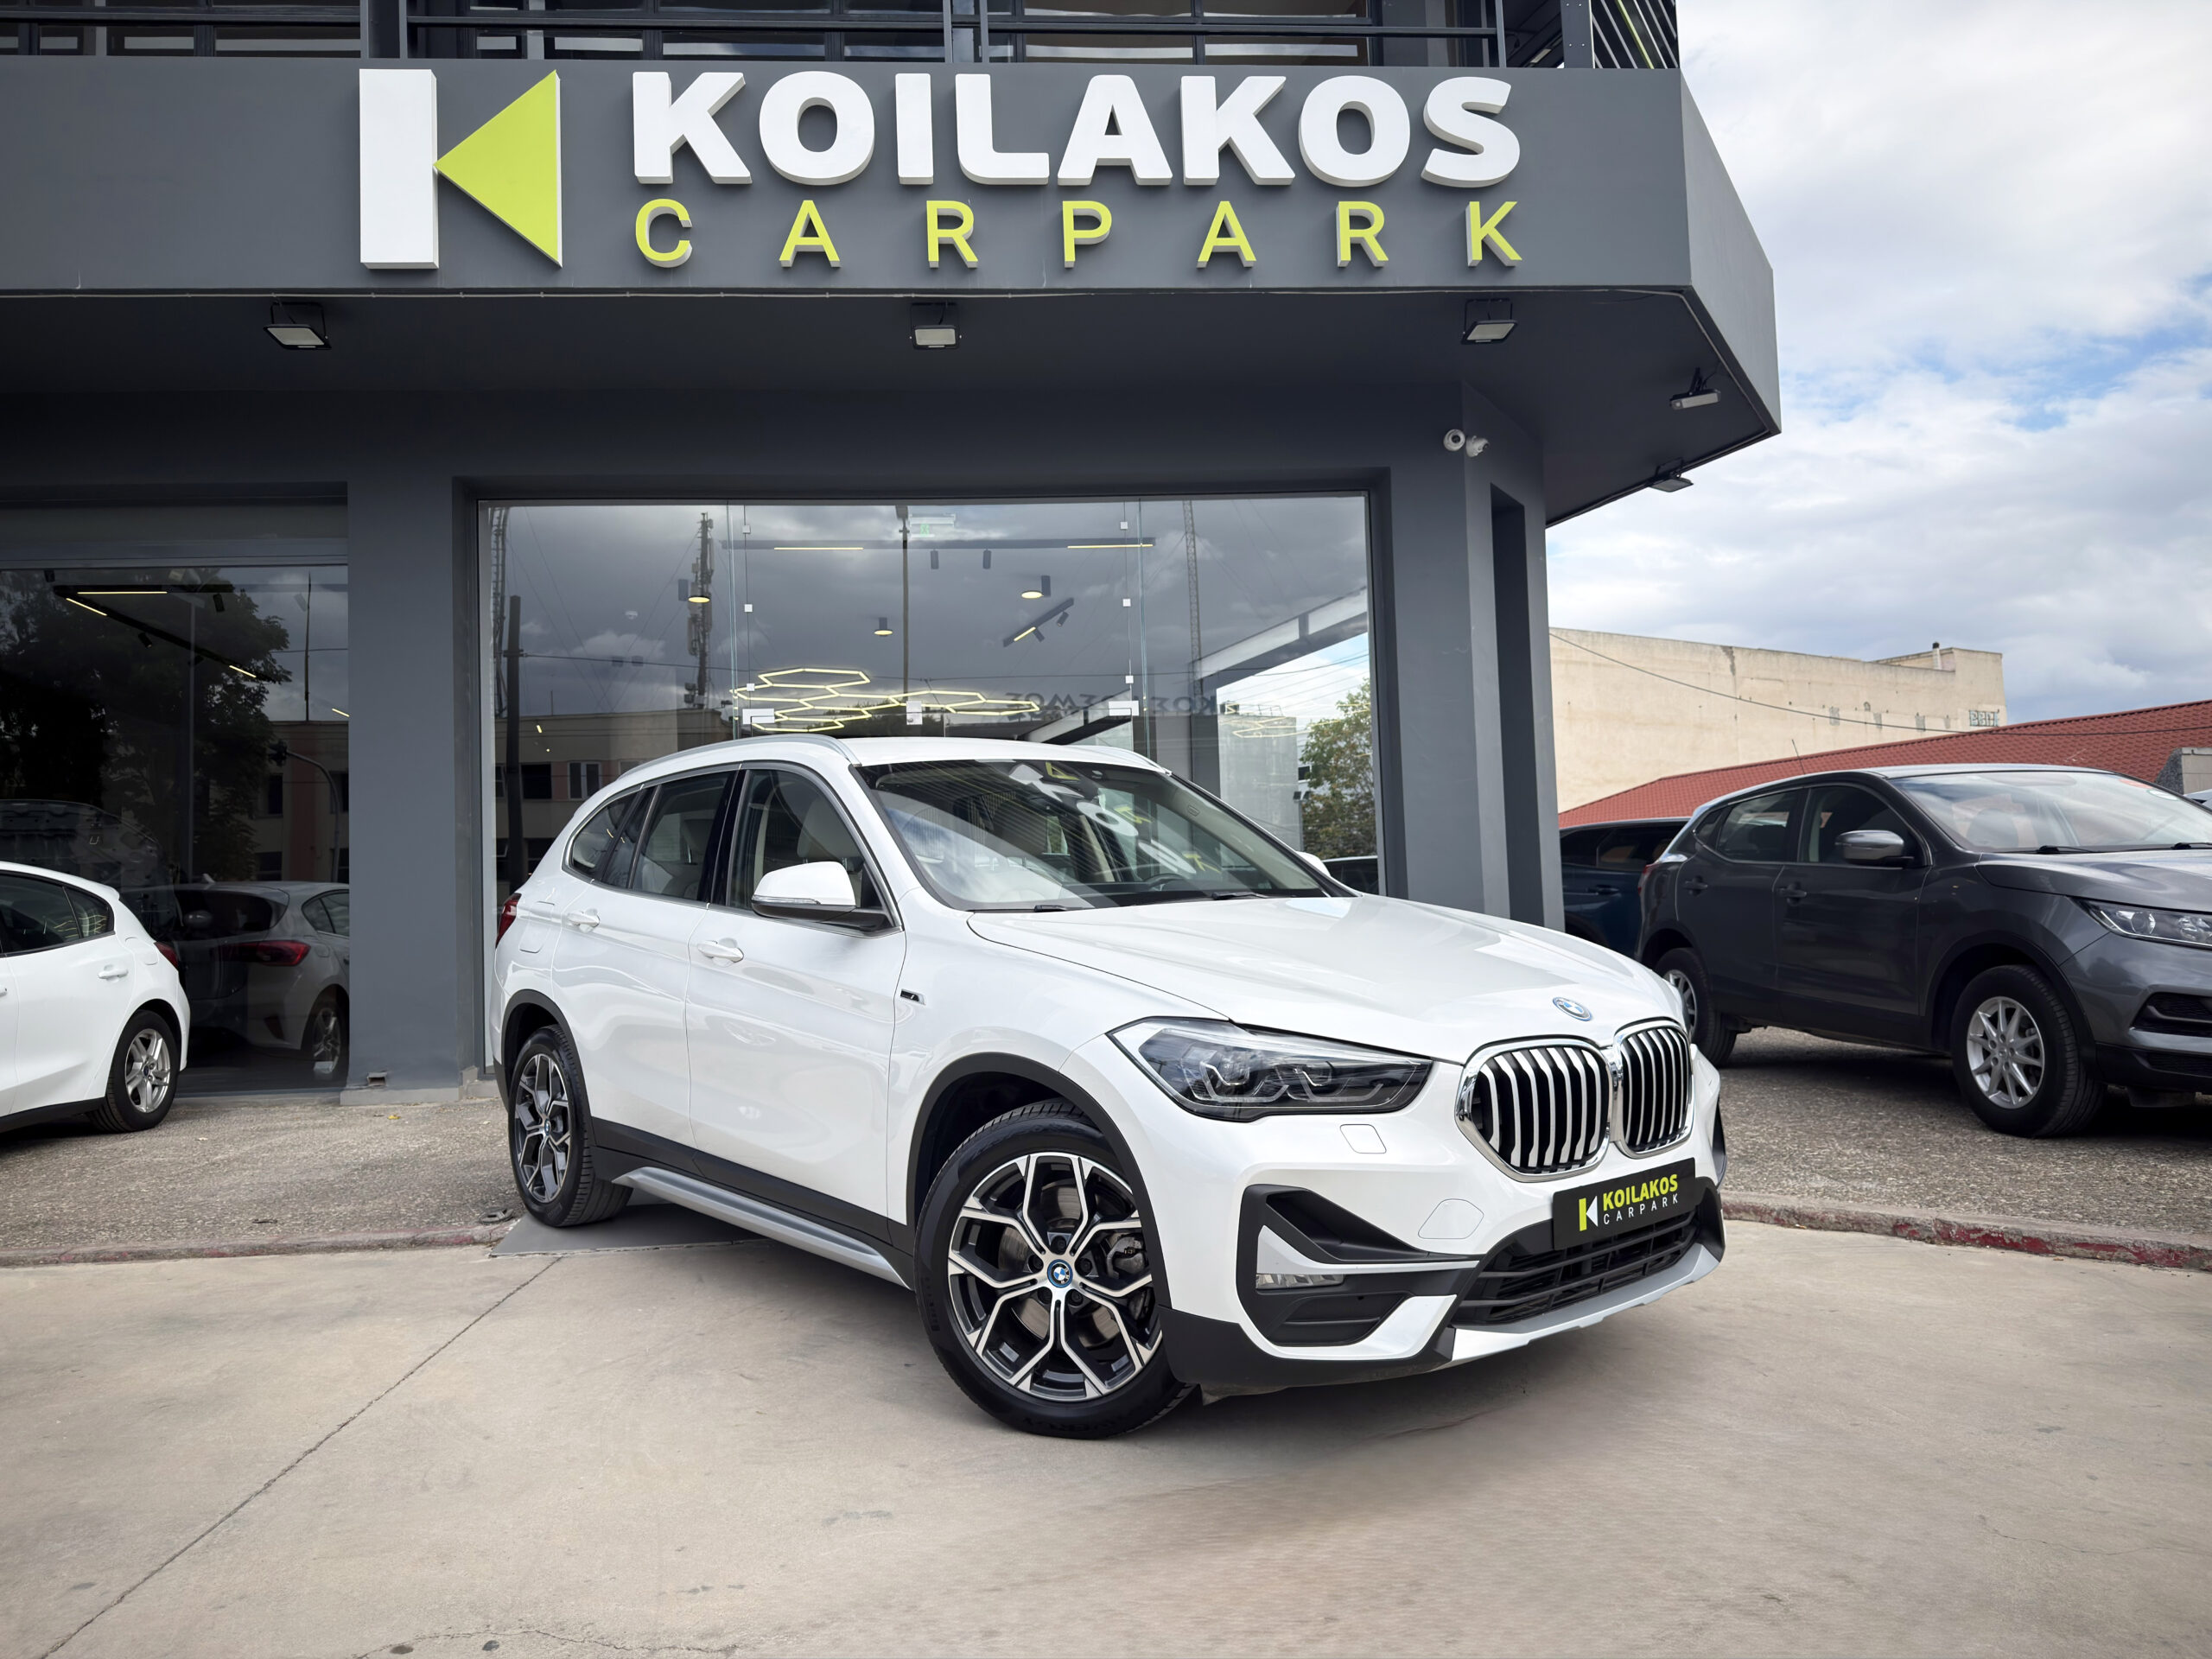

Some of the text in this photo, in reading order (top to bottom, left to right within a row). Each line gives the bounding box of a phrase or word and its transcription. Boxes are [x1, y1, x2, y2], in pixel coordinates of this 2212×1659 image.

[632, 70, 1521, 188] KOILAKOS
[635, 198, 1522, 269] CARPARK
[1603, 1173, 1678, 1211] KOILAKOS
[1603, 1193, 1679, 1225] CARPARK
